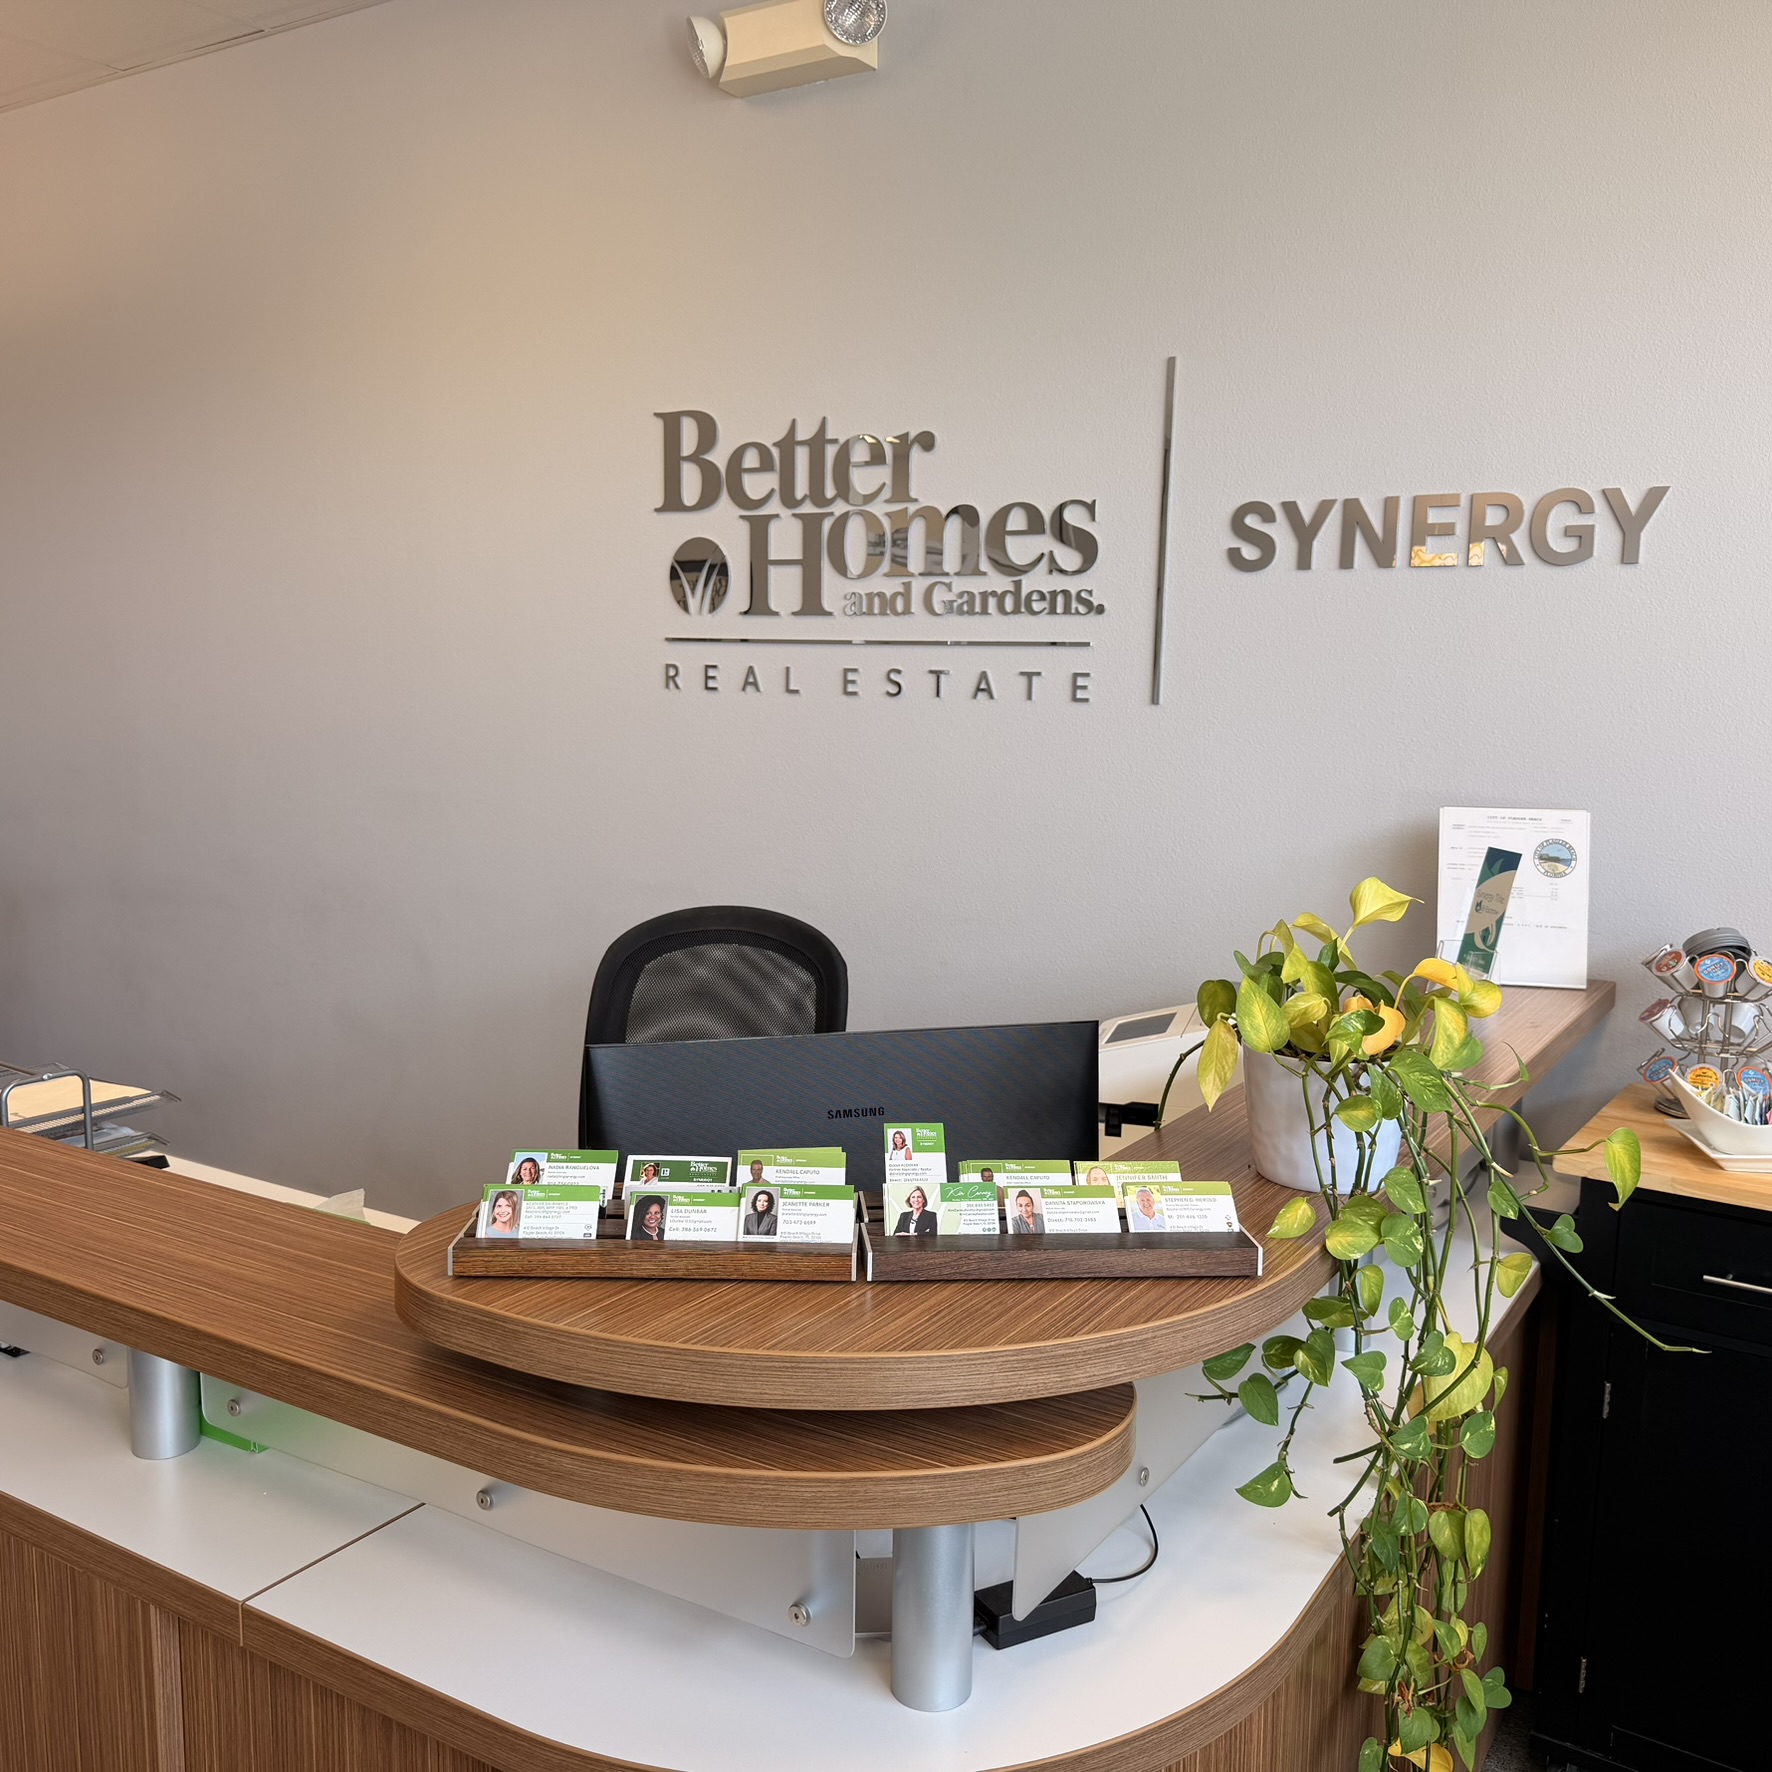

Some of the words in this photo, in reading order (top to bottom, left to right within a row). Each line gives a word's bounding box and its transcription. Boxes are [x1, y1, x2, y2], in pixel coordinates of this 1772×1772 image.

[653, 410, 936, 513] Better
[739, 499, 1099, 616] Homes
[1227, 486, 1671, 573] SYNERGY
[843, 581, 913, 617] and
[923, 579, 1106, 616] Gardens.
[664, 663, 801, 694] REAL
[842, 667, 1092, 702] ESTATE
[827, 1106, 885, 1120] SAMSUNG
